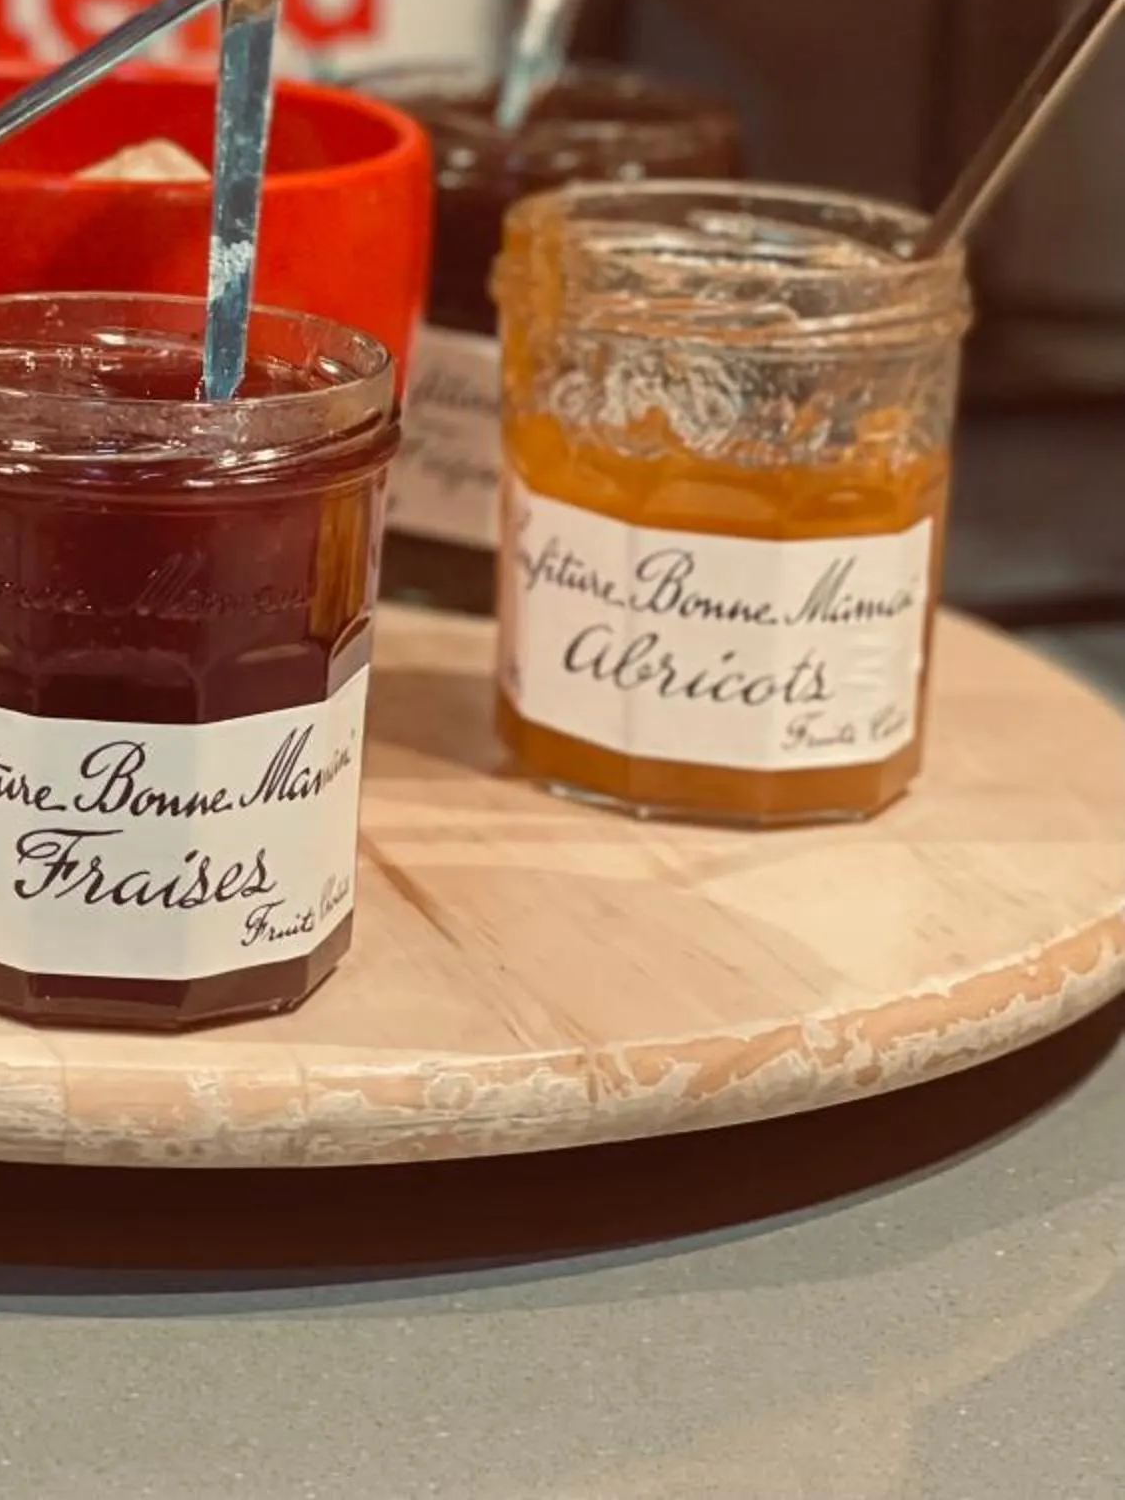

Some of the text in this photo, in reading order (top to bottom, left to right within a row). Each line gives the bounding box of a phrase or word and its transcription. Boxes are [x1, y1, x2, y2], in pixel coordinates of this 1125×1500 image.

[631, 548, 779, 625] Bonne
[562, 624, 833, 708] Abricots
[74, 741, 235, 819] Bonne
[14, 828, 277, 909] Fraises
